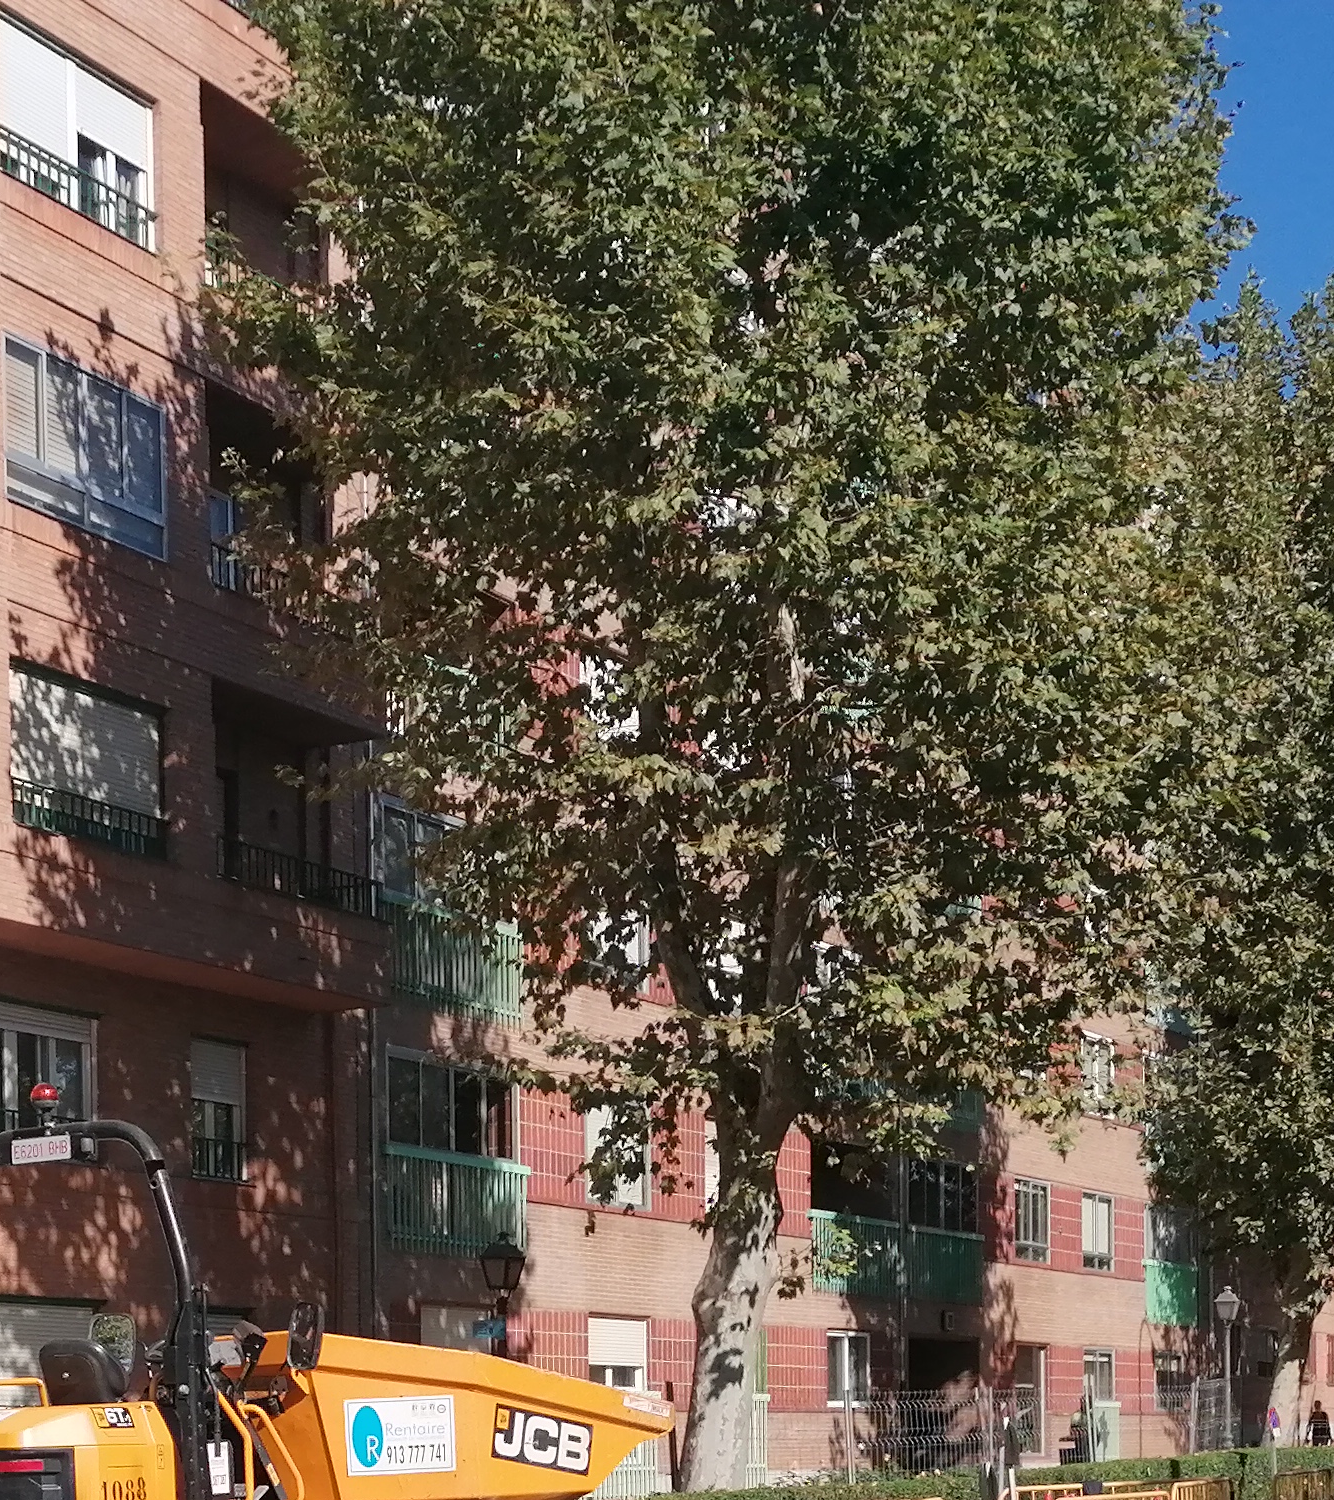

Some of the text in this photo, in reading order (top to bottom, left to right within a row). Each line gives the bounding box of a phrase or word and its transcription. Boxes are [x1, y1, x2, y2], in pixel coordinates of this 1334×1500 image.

[13, 1143, 43, 1160] E6201
[385, 1422, 446, 1437] Rentaire
[366, 1434, 380, 1463] R
[494, 1411, 590, 1471] JCB
[386, 1442, 447, 1464] 913 777 741
